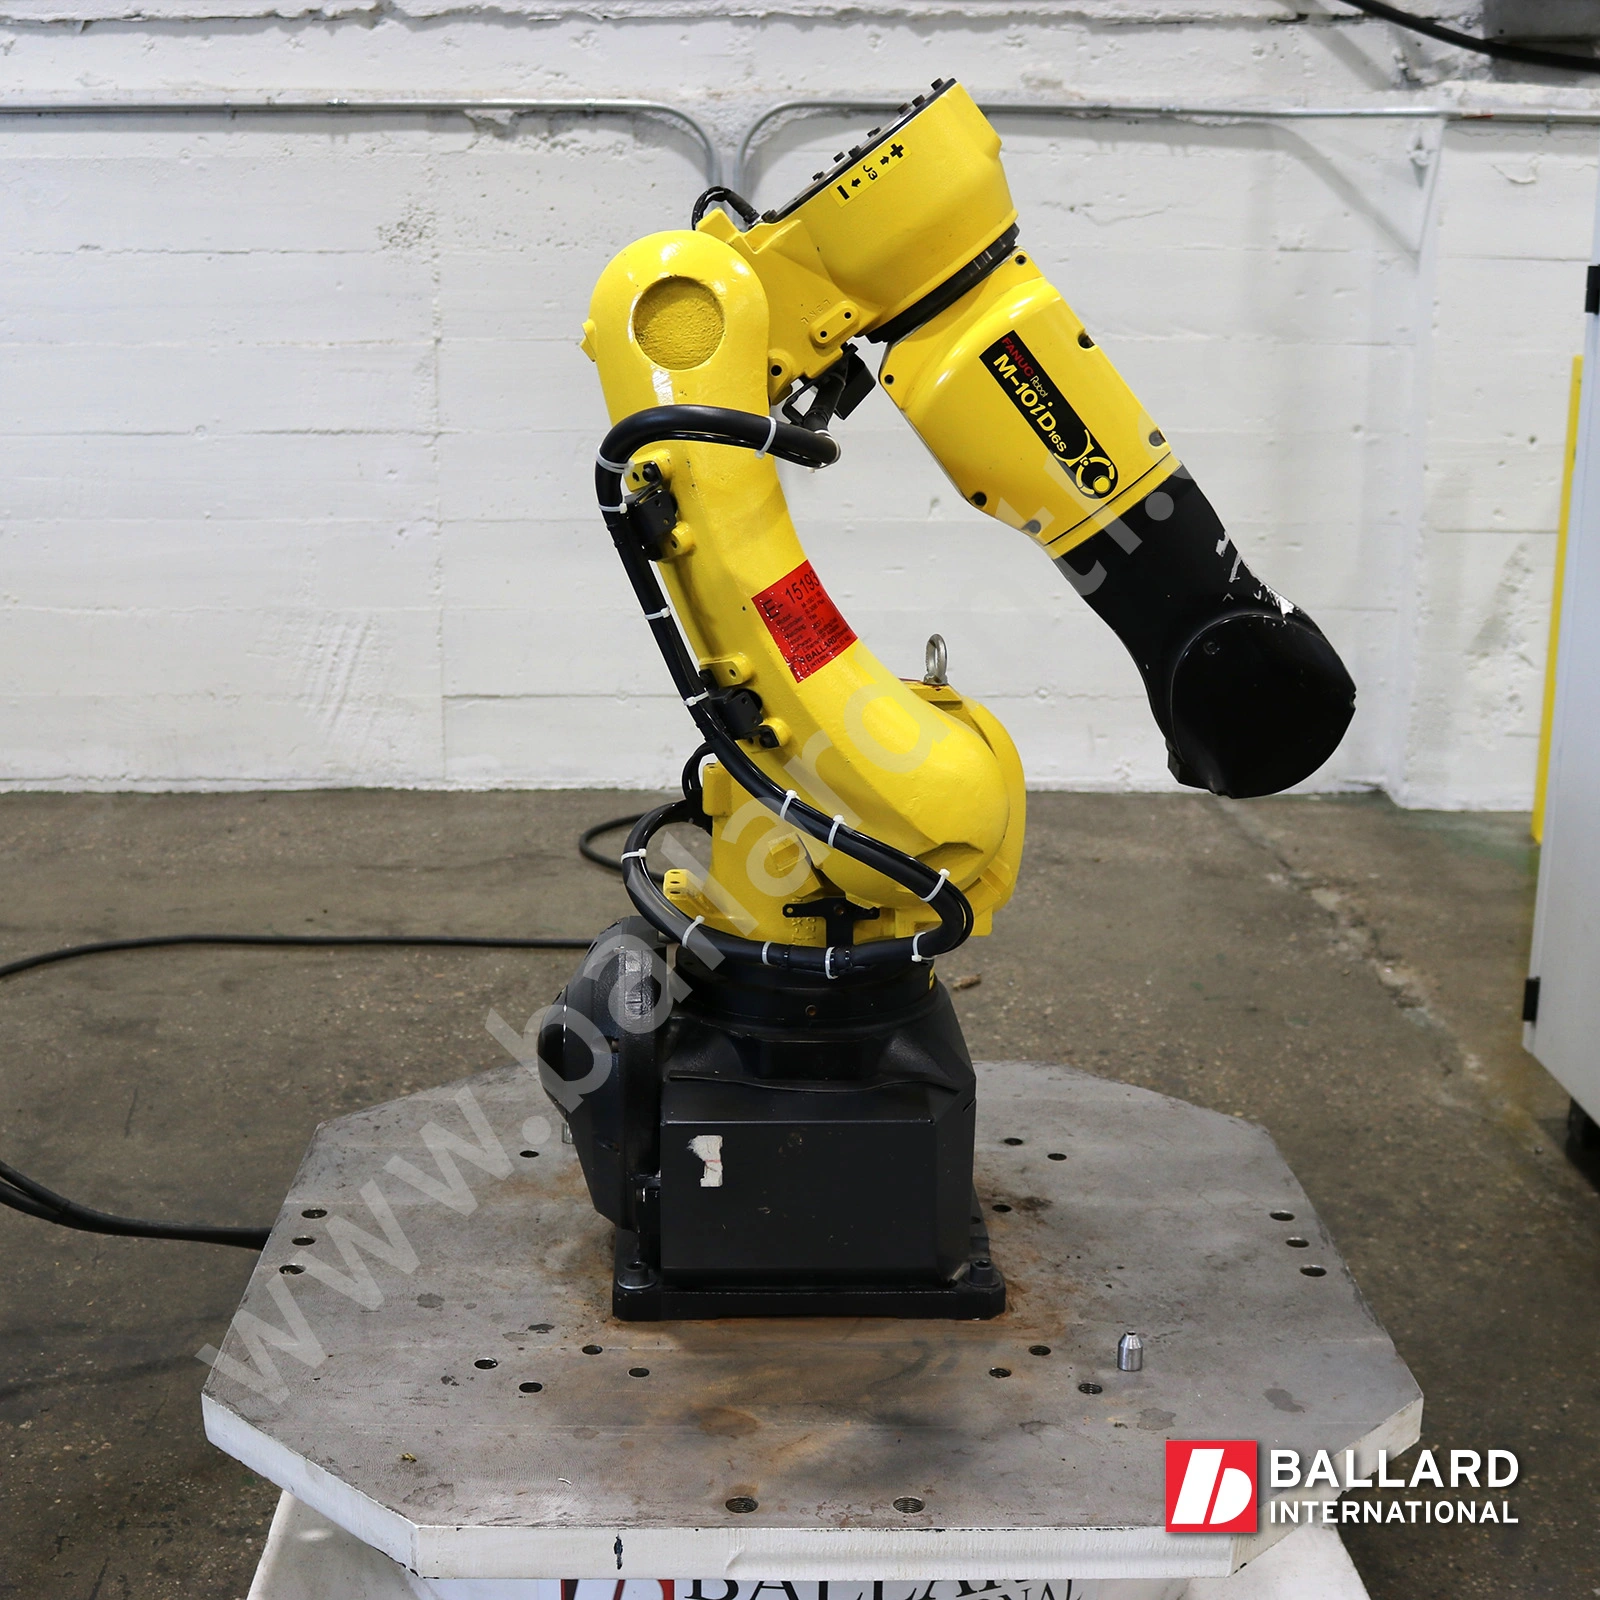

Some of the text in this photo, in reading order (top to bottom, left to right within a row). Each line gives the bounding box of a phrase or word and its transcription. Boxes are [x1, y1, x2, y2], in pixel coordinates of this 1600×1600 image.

[862, 164, 878, 180] J3
[1001, 336, 1048, 398] FANUC Robot
